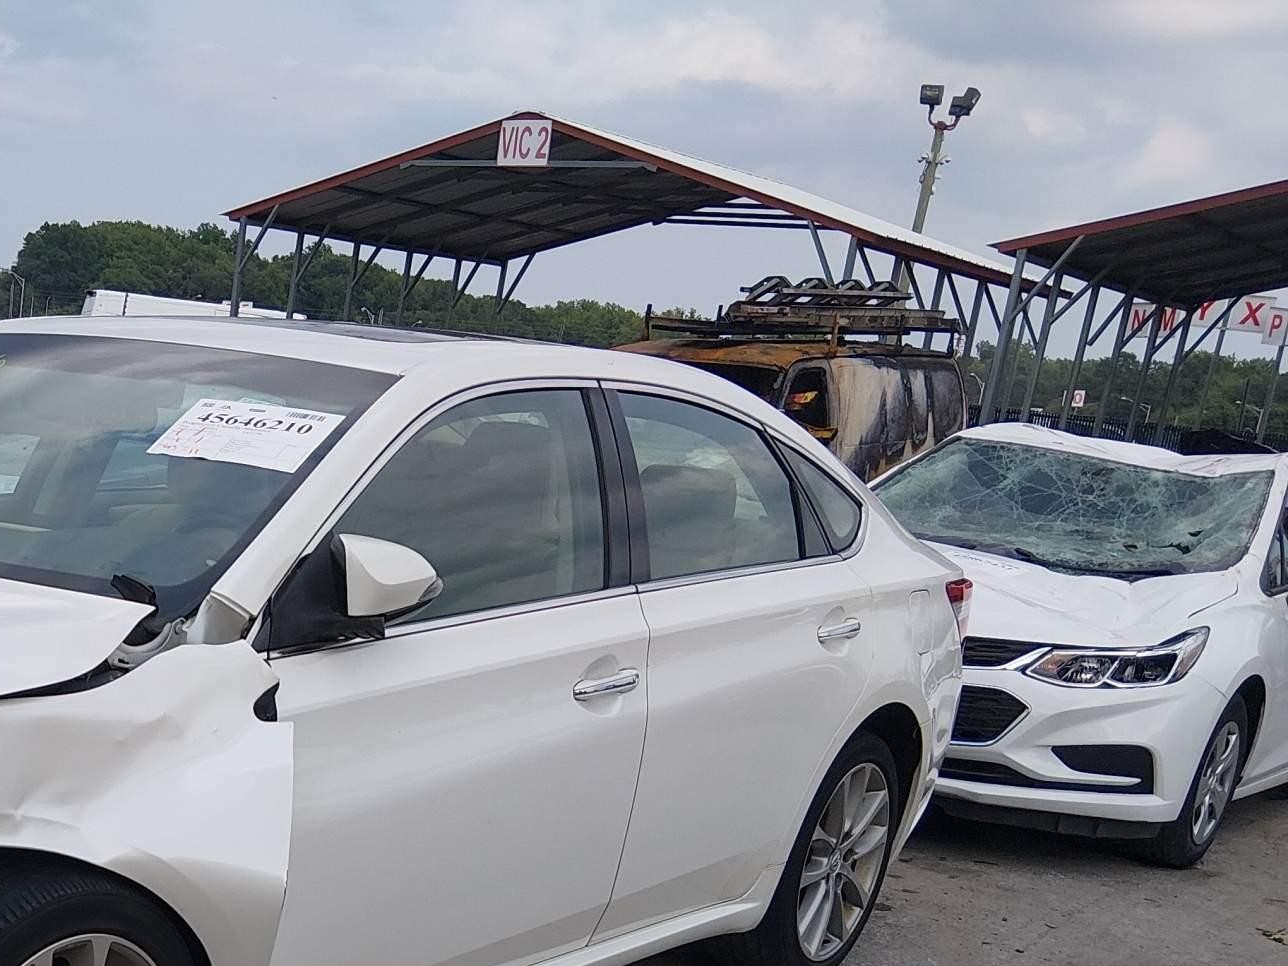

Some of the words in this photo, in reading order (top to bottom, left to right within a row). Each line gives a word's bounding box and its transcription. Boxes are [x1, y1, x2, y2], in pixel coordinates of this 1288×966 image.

[502, 125, 533, 160] VIC
[535, 126, 549, 159] 2
[1239, 301, 1265, 327] X
[1268, 314, 1283, 338] P
[196, 411, 314, 435] 45646210
